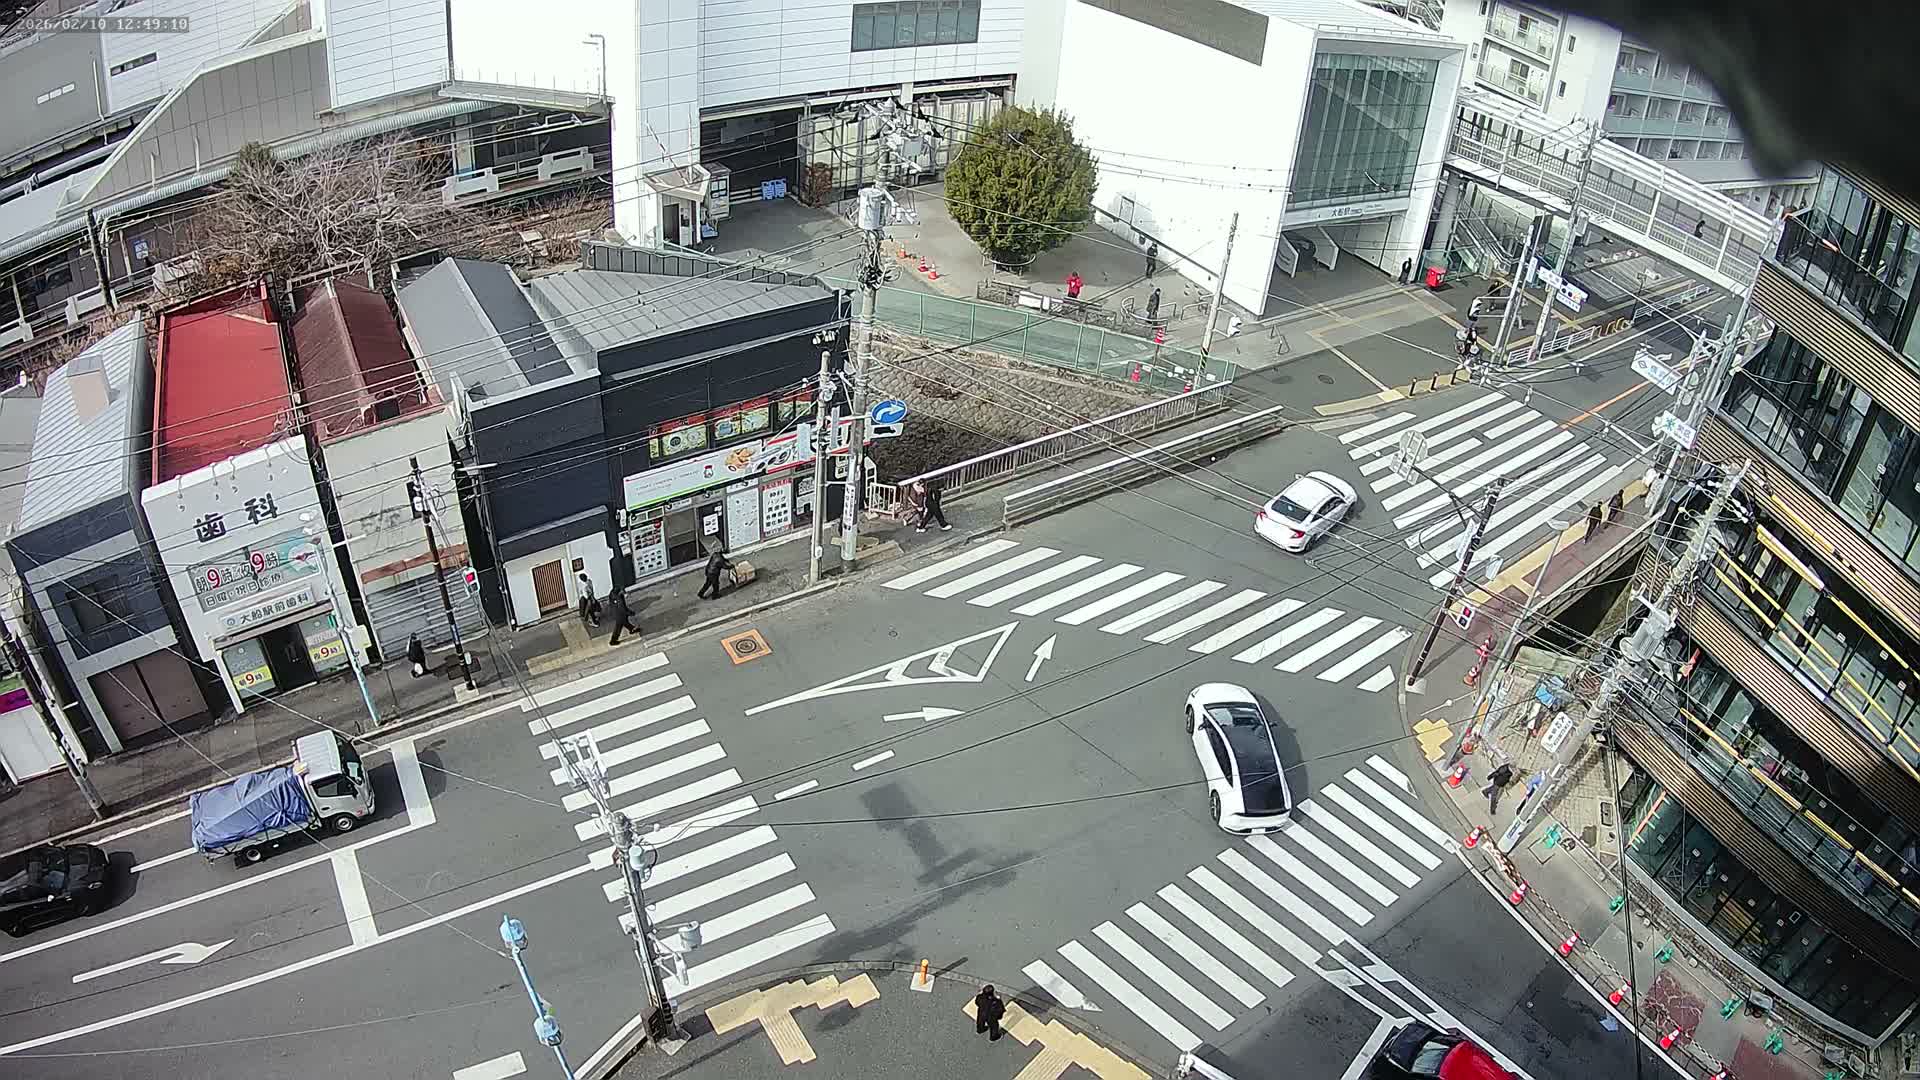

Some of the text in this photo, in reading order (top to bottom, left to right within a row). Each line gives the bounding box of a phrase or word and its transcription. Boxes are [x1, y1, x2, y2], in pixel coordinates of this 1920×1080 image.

[193, 493, 278, 542] 歯科
[240, 592, 309, 624] 大船駅前歯科
